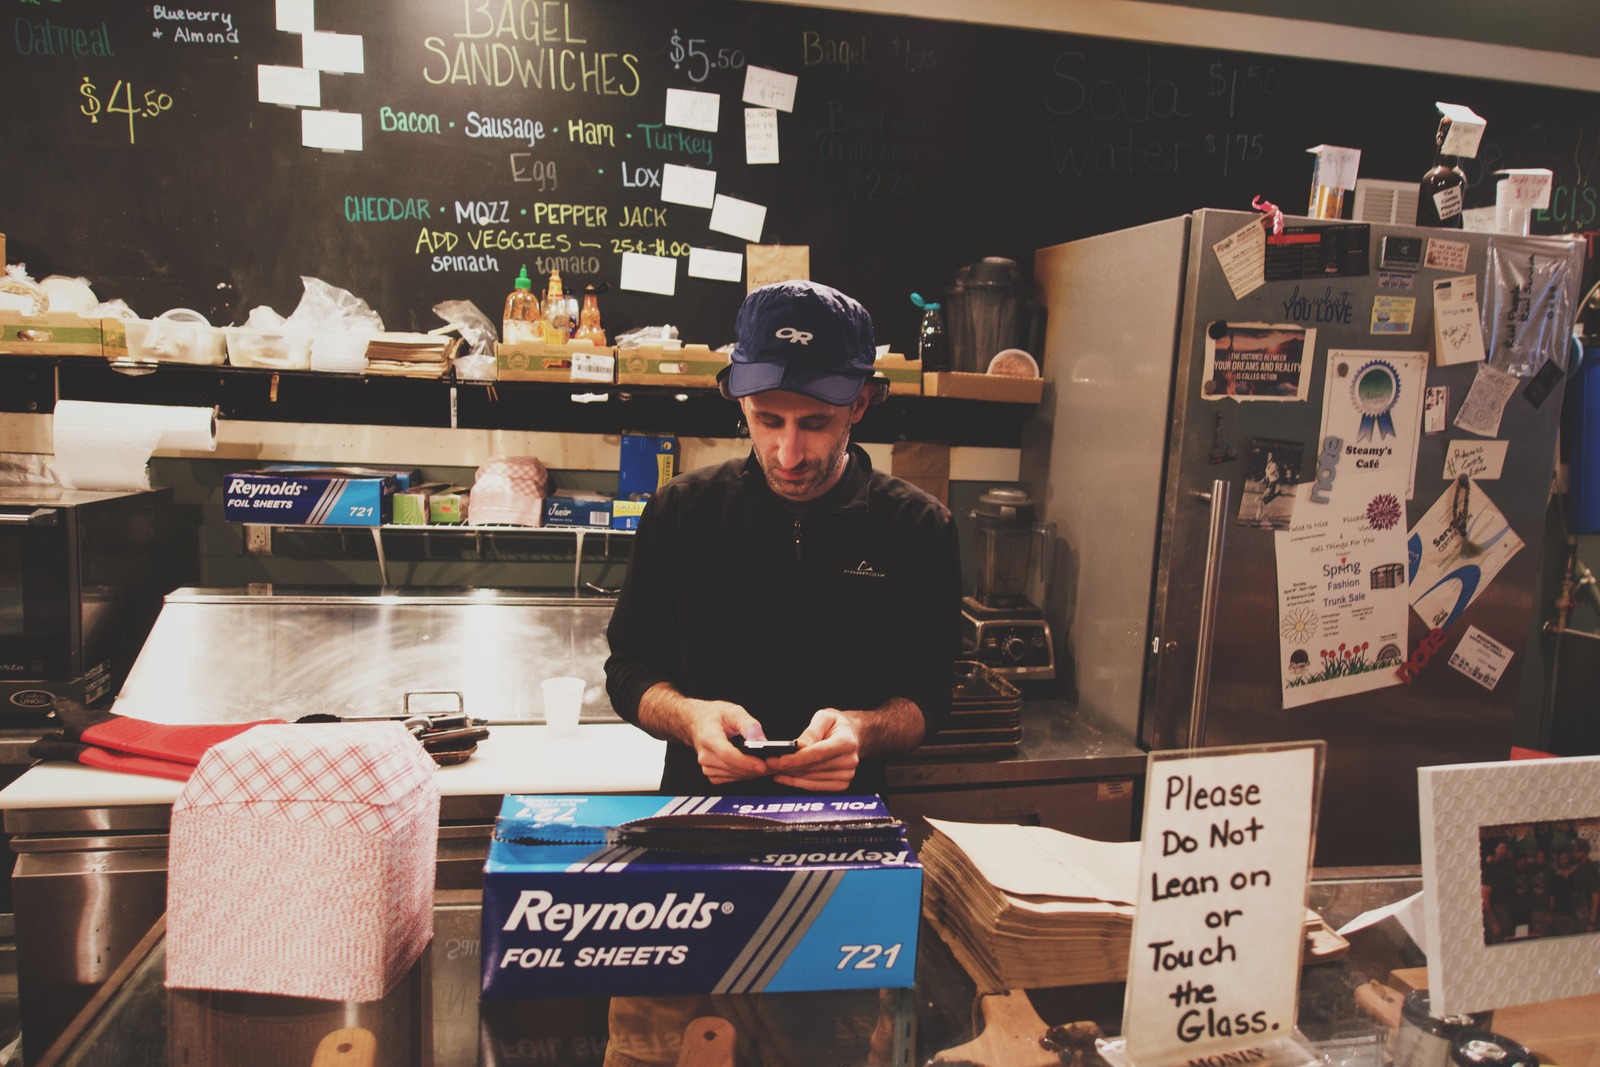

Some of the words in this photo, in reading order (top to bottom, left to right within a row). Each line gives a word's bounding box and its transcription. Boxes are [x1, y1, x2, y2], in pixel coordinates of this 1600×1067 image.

[152, 4, 232, 31] Blueberry
[454, 0, 586, 44] BAGEL
[15, 16, 115, 63] Oatmeal
[174, 28, 240, 44] Almond
[423, 36, 641, 97] SANDWICHES
[669, 28, 745, 83] $5.50
[802, 29, 869, 74] Bagel
[1044, 50, 1193, 124] Soda
[80, 76, 173, 145] $4.50
[380, 105, 441, 135] Bacon
[464, 112, 546, 147] Sausage
[568, 118, 615, 147] Ham
[637, 123, 714, 166] Turkey
[1048, 124, 1197, 178] Water
[509, 152, 557, 192] Egg
[622, 161, 661, 188] Lox
[344, 195, 432, 223] CHEDDAR
[455, 200, 510, 226] MOZZ
[534, 201, 607, 227] PEPPER
[619, 206, 667, 228] JACK
[415, 227, 459, 255] ADD
[469, 230, 572, 253] VEGGIES
[431, 254, 499, 273] spinach
[536, 254, 600, 275] tomato
[1284, 302, 1312, 320] YOU
[1316, 304, 1353, 324] LOVE
[775, 326, 814, 346] OR
[1214, 361, 1231, 370] YOUR
[1232, 361, 1259, 371] DREAMS
[1261, 362, 1273, 371] AND
[1275, 362, 1301, 372] REALITY
[1231, 352, 1240, 360] THE
[1241, 353, 1263, 361] DISTANCE
[1264, 353, 1287, 361] BETWEEN
[1345, 445, 1392, 456] Steamy's
[1356, 459, 1379, 469] Café
[227, 499, 250, 508] FOIL
[252, 500, 293, 509] SHEETS
[349, 506, 374, 517] 721
[1326, 542, 1348, 551] Things
[1362, 537, 1375, 546] You
[1322, 561, 1361, 579] Spring
[1327, 578, 1360, 591] Fashion
[1323, 596, 1347, 608] Trunk
[1348, 592, 1366, 604] Sale
[1395, 627, 1449, 686] note
[830, 801, 878, 811] FOIL
[1166, 775, 1262, 811] Please
[1162, 829, 1198, 857] Do
[1209, 817, 1264, 849] Not
[1151, 871, 1218, 902] Lean
[1230, 868, 1271, 890] on
[1205, 908, 1243, 930] or
[500, 947, 565, 969] FOIL
[574, 945, 689, 967] SHEETS
[836, 943, 903, 970] 721
[1148, 937, 1236, 972] Touch
[1168, 980, 1216, 1007] the
[1176, 1008, 1280, 1043] Glass.
